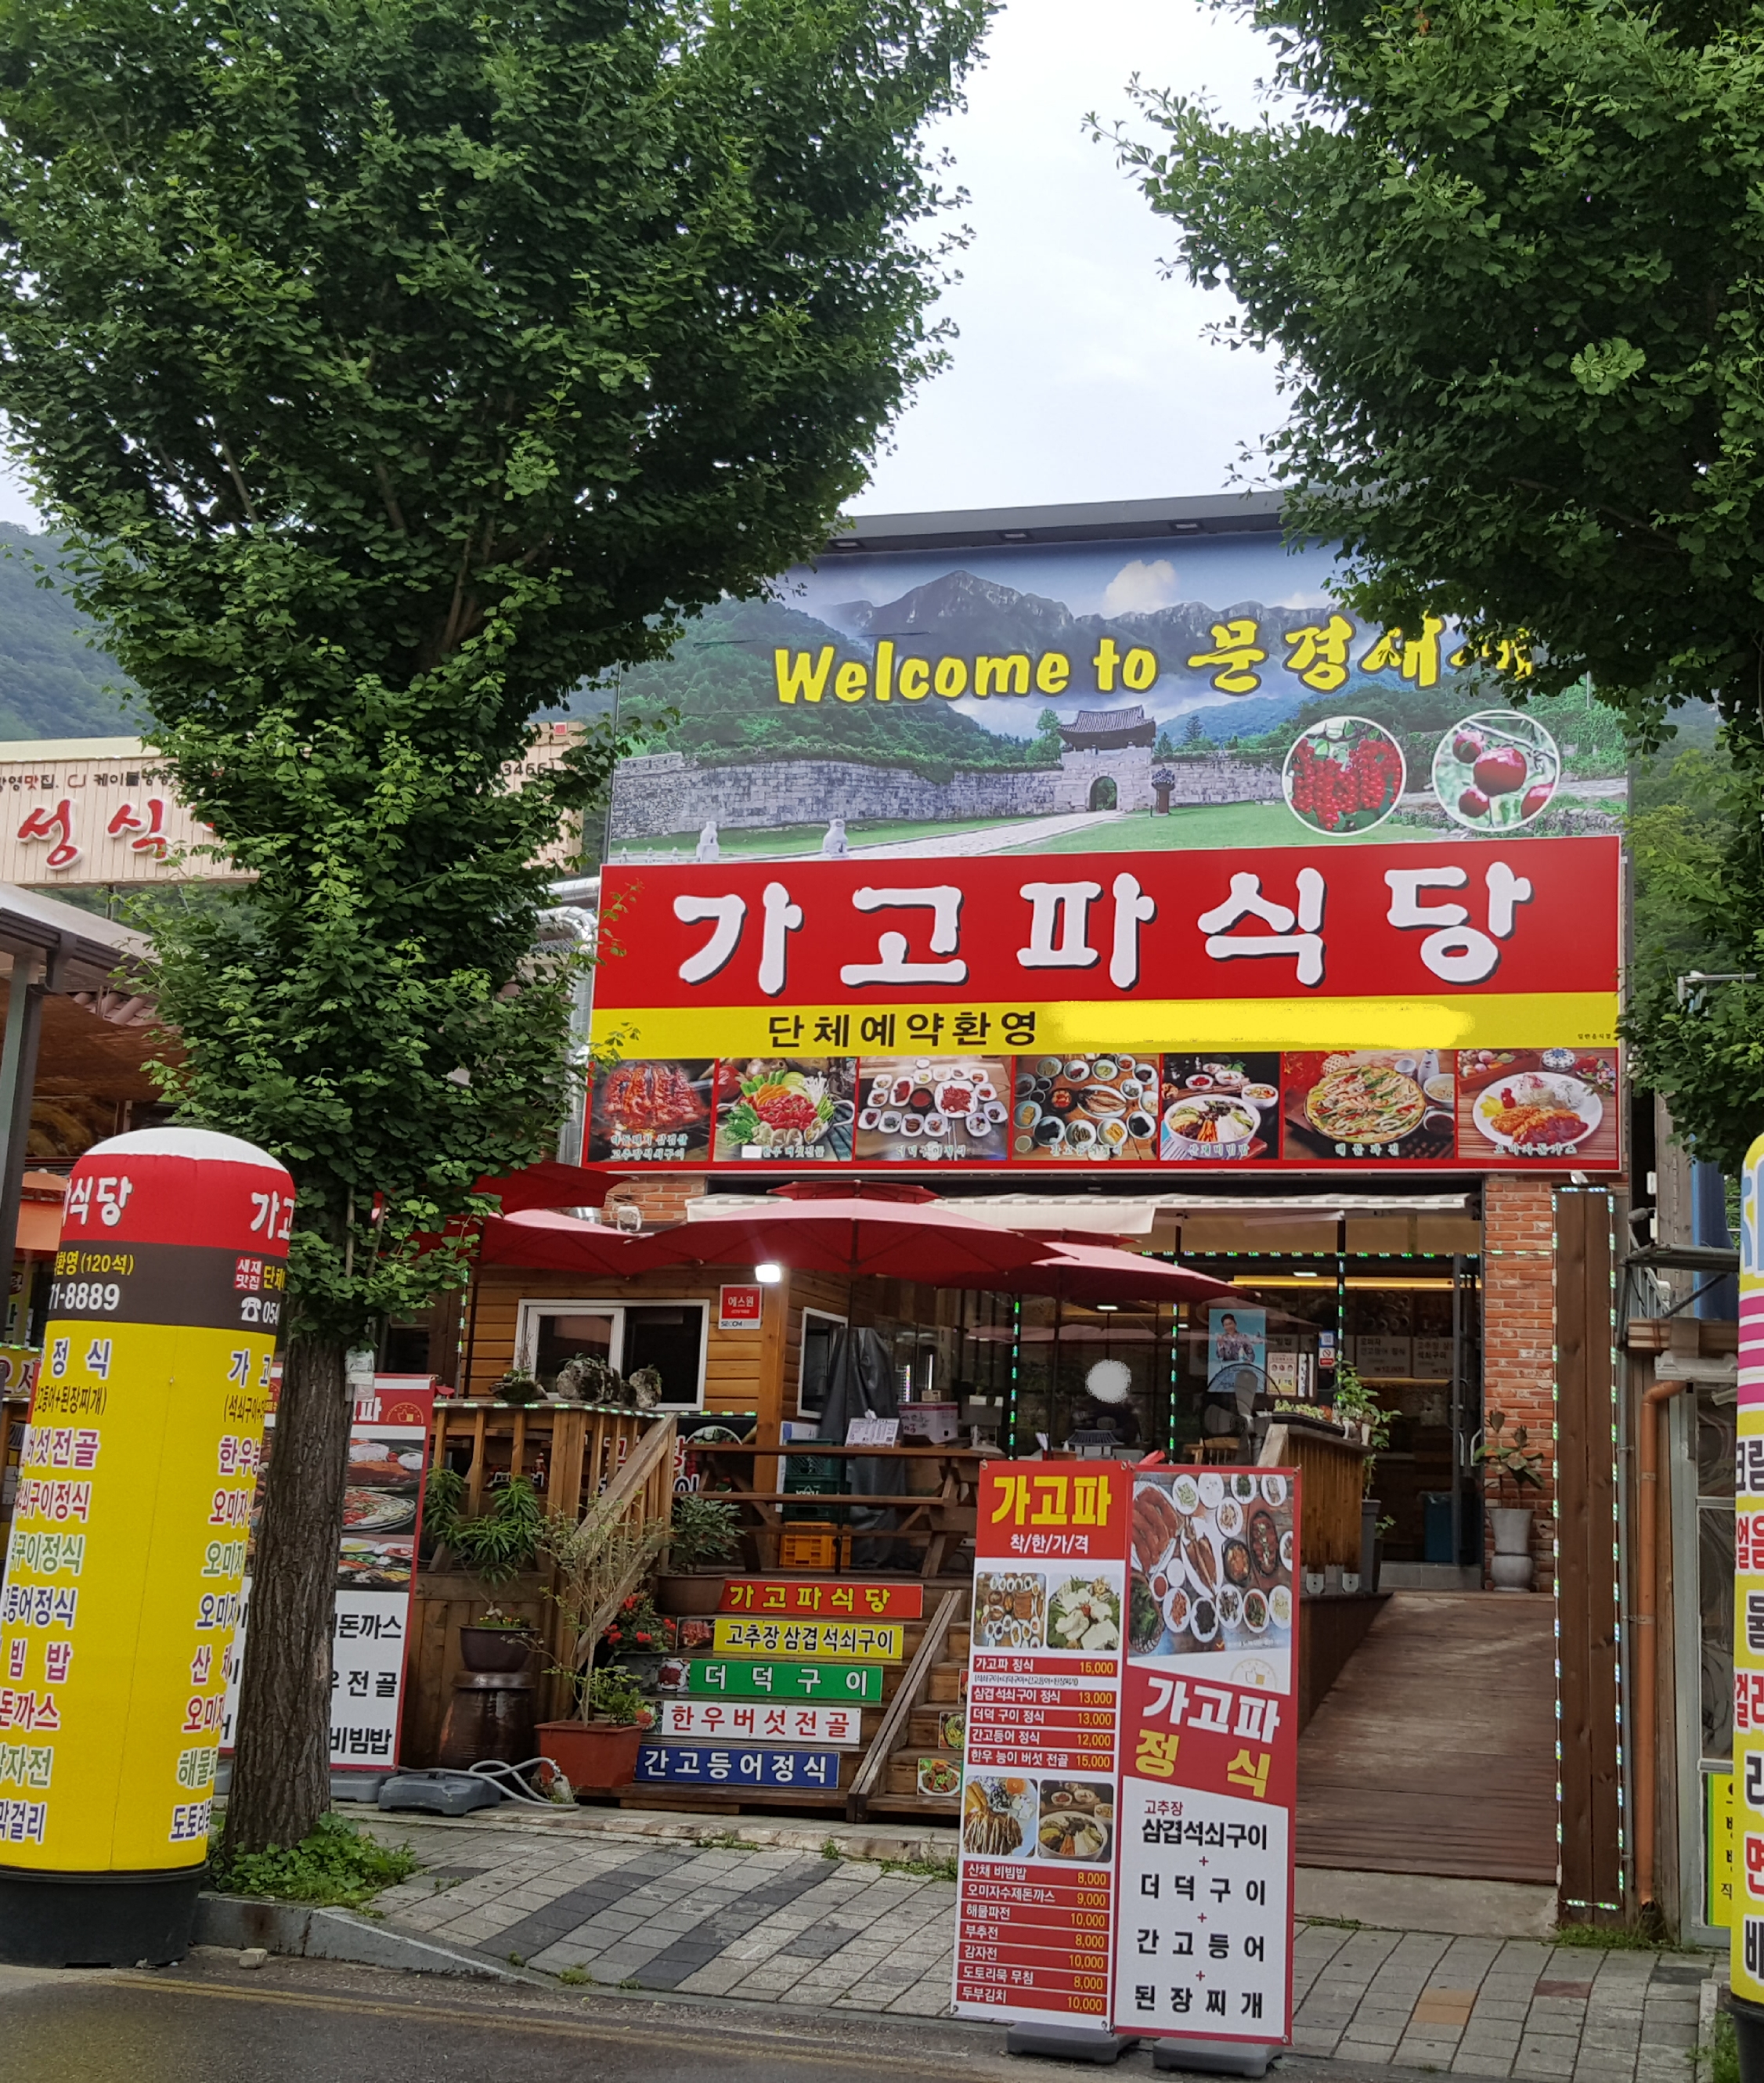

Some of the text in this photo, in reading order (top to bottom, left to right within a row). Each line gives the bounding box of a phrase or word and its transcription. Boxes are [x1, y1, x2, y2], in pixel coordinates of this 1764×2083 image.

[775, 641, 1070, 704] Welcome
[1095, 637, 1156, 691] to
[673, 861, 1533, 996] 가고파식당
[768, 1010, 1037, 1049] 단체예약환영
[63, 1175, 134, 1227] 식당
[81, 1252, 135, 1276] (120석)
[727, 1295, 754, 1307] 에스원
[991, 1475, 1113, 1526] 가고파
[9, 1531, 86, 1576] 구이정식
[1010, 1533, 1089, 1554] 착/한/가/격
[729, 1585, 892, 1613] 가고파식당
[334, 1613, 402, 1639] 돈까스
[975, 1658, 1114, 1674] 가고파 정식 15,000
[704, 1664, 868, 1697] 더덕구이
[1040, 1690, 1061, 1704] 정식
[1078, 1691, 1113, 1705] 13,000
[1142, 1676, 1281, 1745] 가고파
[671, 1705, 850, 1738] 한우버섯전골
[973, 1708, 1112, 1726] 더덕 구이 정식 13,000
[972, 1728, 1111, 1747] 간고등어 정식 12,000
[643, 1749, 828, 1784] 간고등어정식
[971, 1749, 993, 1763] 한우
[1021, 1752, 1043, 1765] 버섯
[1046, 1753, 1069, 1767] 전골
[1076, 1754, 1110, 1768] 15,000
[1135, 1728, 1272, 1799] 정식
[1144, 1800, 1184, 1816] 고추장
[1141, 1818, 1268, 1850] 삼겹석쇠구이
[968, 1864, 1107, 1886] 산채 비빔밥 8,000
[966, 1884, 1106, 1907] 오미자수제돈까스 9,000
[1140, 1873, 1266, 1906] 더덕구이
[965, 1904, 1106, 1927] 해물파전 10,000
[965, 1925, 1105, 1948] 부추전 8,000
[1136, 1929, 1264, 1962] 간고등어
[964, 1945, 1104, 1969] 감자전 10,000
[963, 1966, 1104, 1991] 도토리묵 무침 8,000
[961, 1986, 1103, 2012] 두부김치 10,000
[1135, 1984, 1264, 2019] 된장찌개
